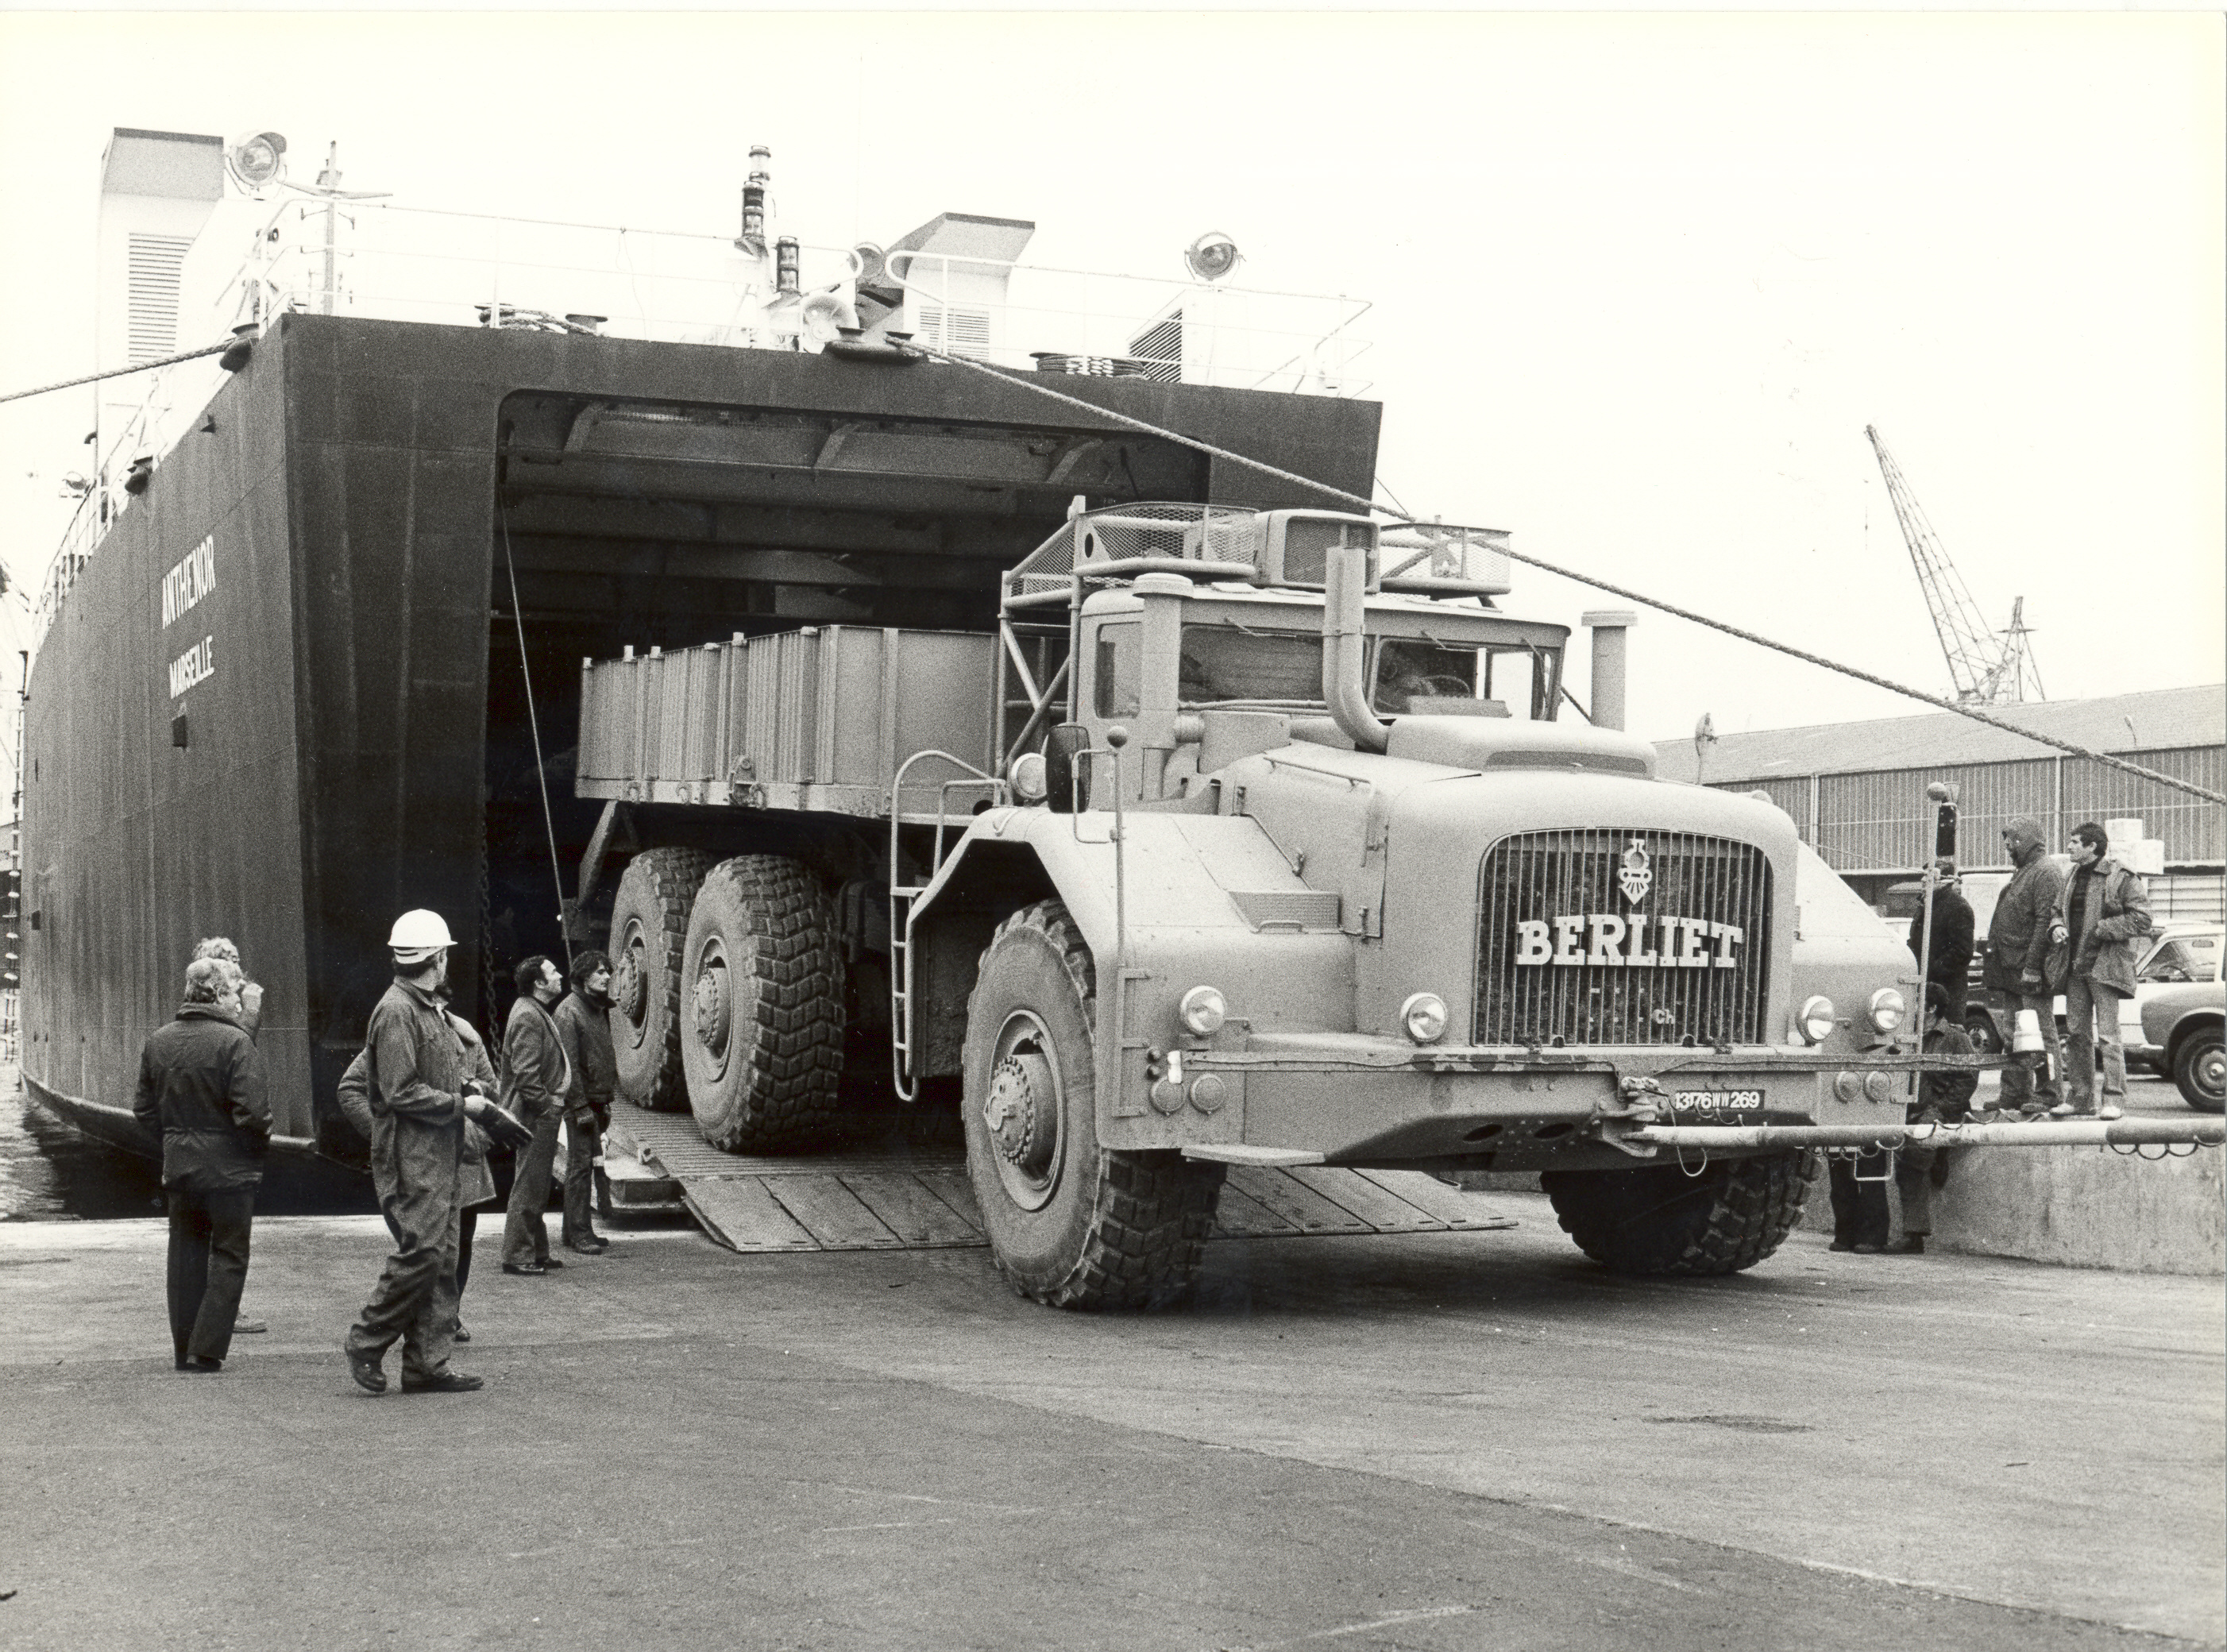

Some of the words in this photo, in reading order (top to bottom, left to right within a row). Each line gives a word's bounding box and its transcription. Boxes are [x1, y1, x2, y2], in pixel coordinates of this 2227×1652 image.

[162, 534, 216, 630] ANTHENOR
[169, 635, 215, 699] MARSEILLE
[1516, 913, 1743, 968] BERLIET
